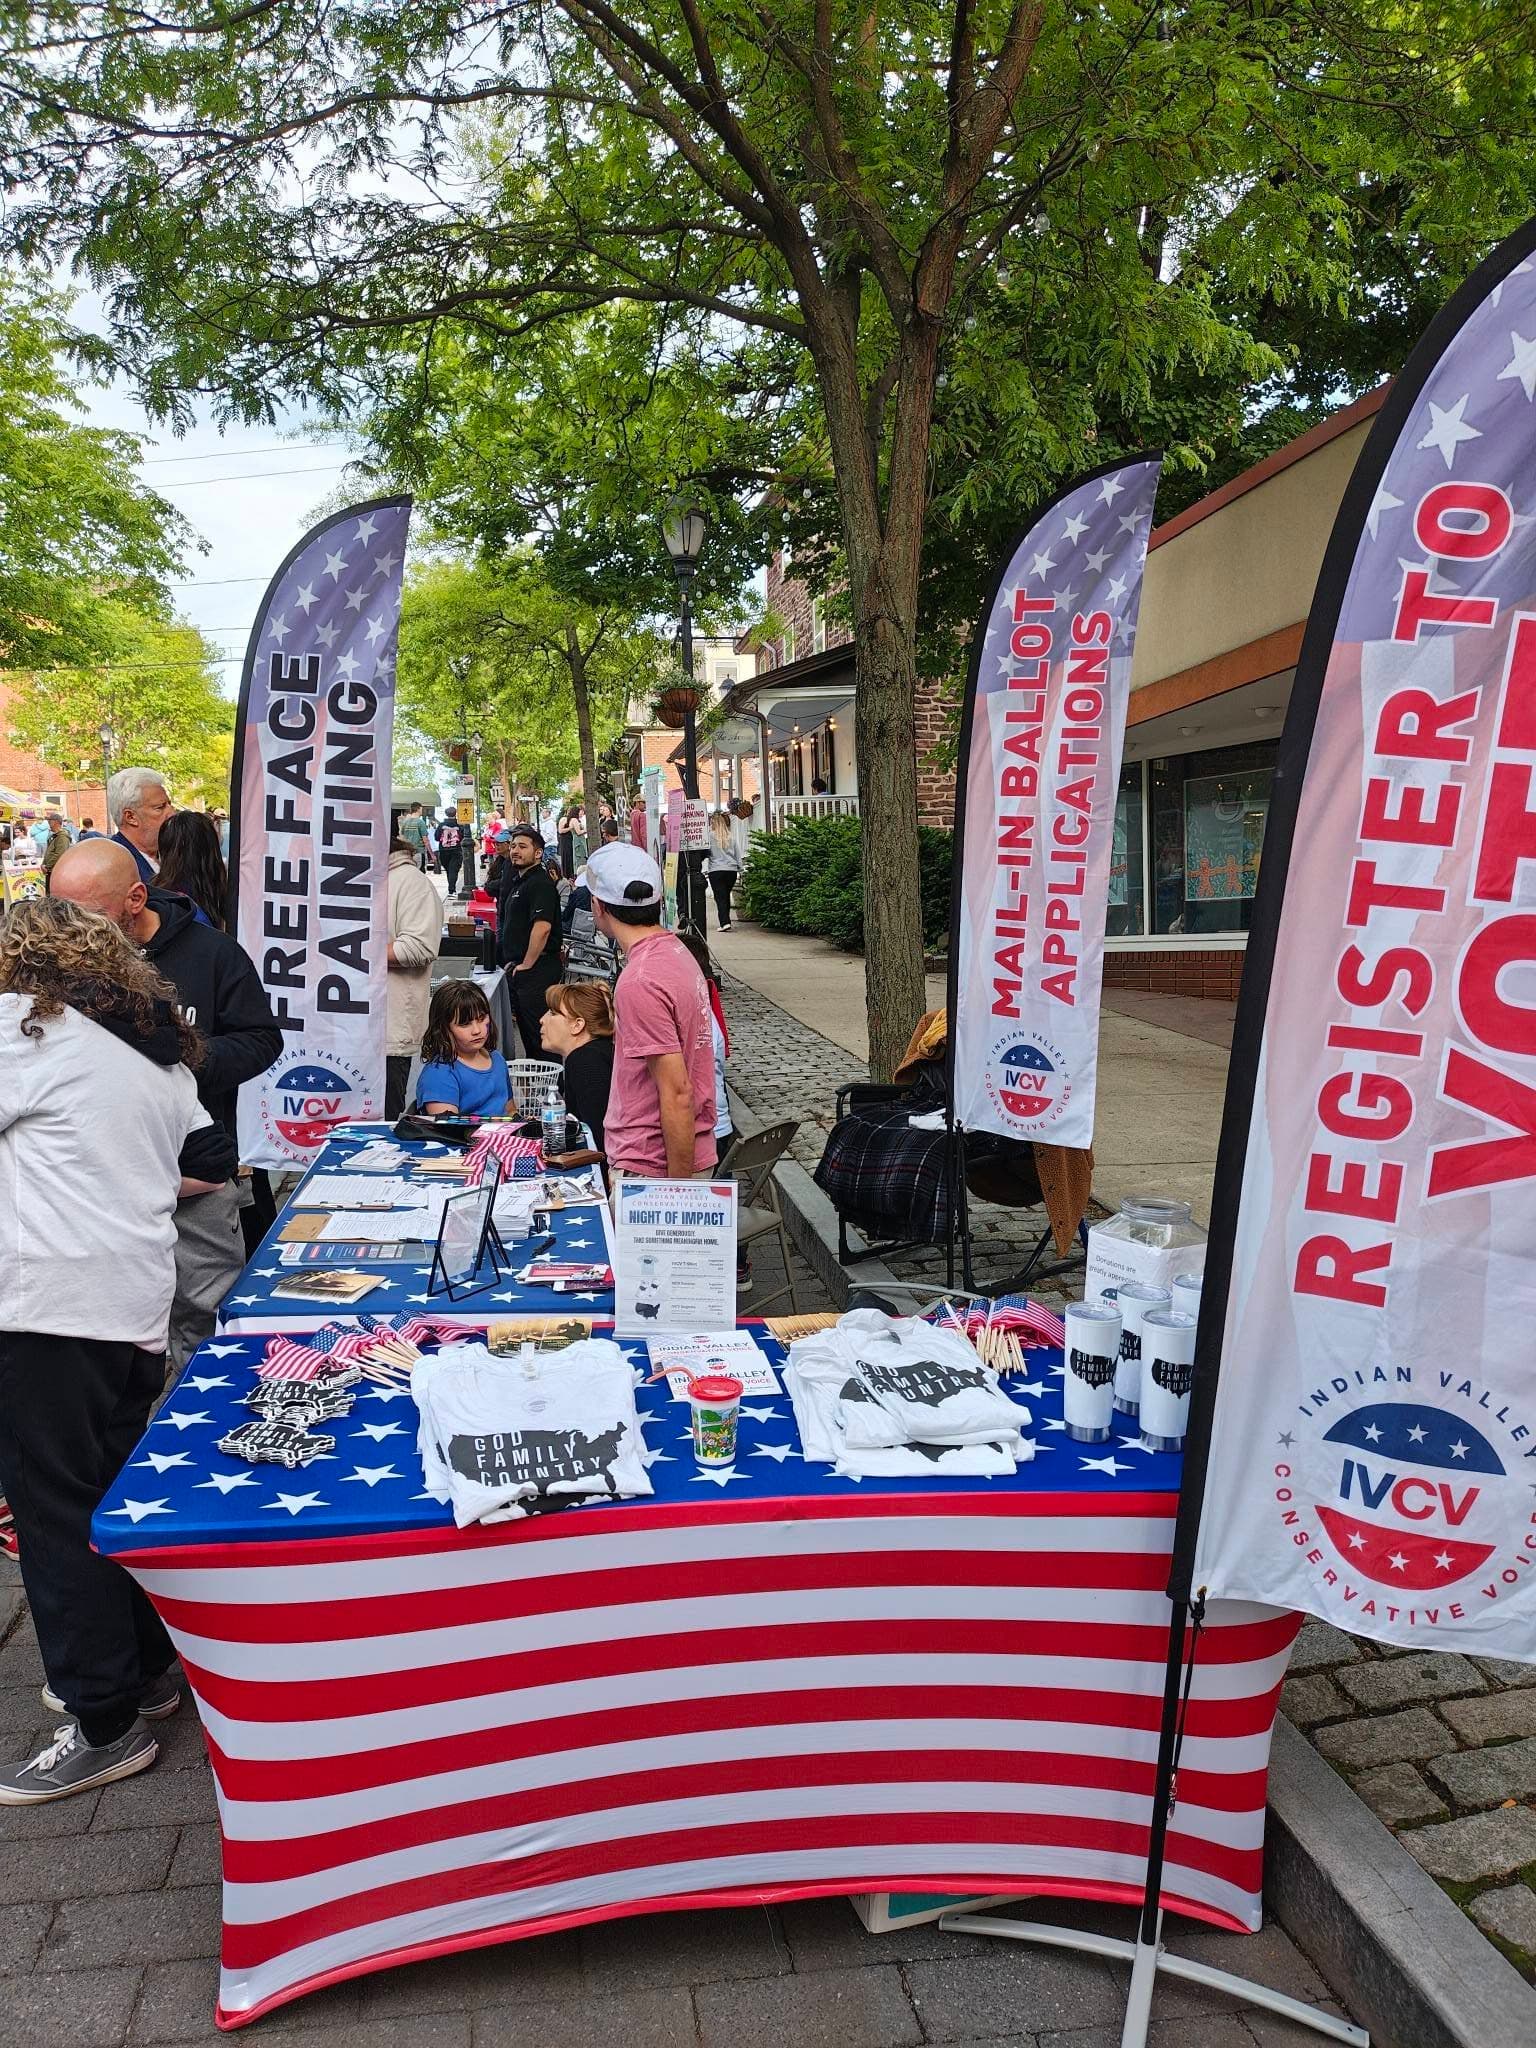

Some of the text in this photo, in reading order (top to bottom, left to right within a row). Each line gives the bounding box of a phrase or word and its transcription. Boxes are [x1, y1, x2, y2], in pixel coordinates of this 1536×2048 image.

[992, 588, 1057, 1018] MAIL-IN BALLOT
[1040, 610, 1111, 1006] APPLICATIONS
[264, 652, 321, 1033] FREE FACE
[317, 678, 380, 1015] PAINTING
[1293, 479, 1514, 1308] REGISTER TO
[991, 1031, 1067, 1066] INDIAN VALLEY
[266, 1049, 366, 1083] INDIAN VALLEY
[1005, 1070, 1046, 1091] IVCV
[283, 1096, 341, 1117] IVCV
[985, 1073, 1072, 1131] CONSERVATIVE VOICE
[629, 1210, 725, 1226] NIGHT OF IMPACT
[1096, 1255, 1136, 1274] Donations are
[1076, 1352, 1094, 1362] GOD
[1076, 1360, 1109, 1372] FAMILY
[1161, 1362, 1179, 1371] GOD
[1299, 1366, 1412, 1417] INDIAN
[474, 1431, 523, 1452] GOD
[477, 1443, 576, 1469] FAMILY
[480, 1456, 601, 1488] COUNTRY
[1339, 1458, 1481, 1526] IVCV
[1274, 1464, 1466, 1625] CONSERVATIVE
